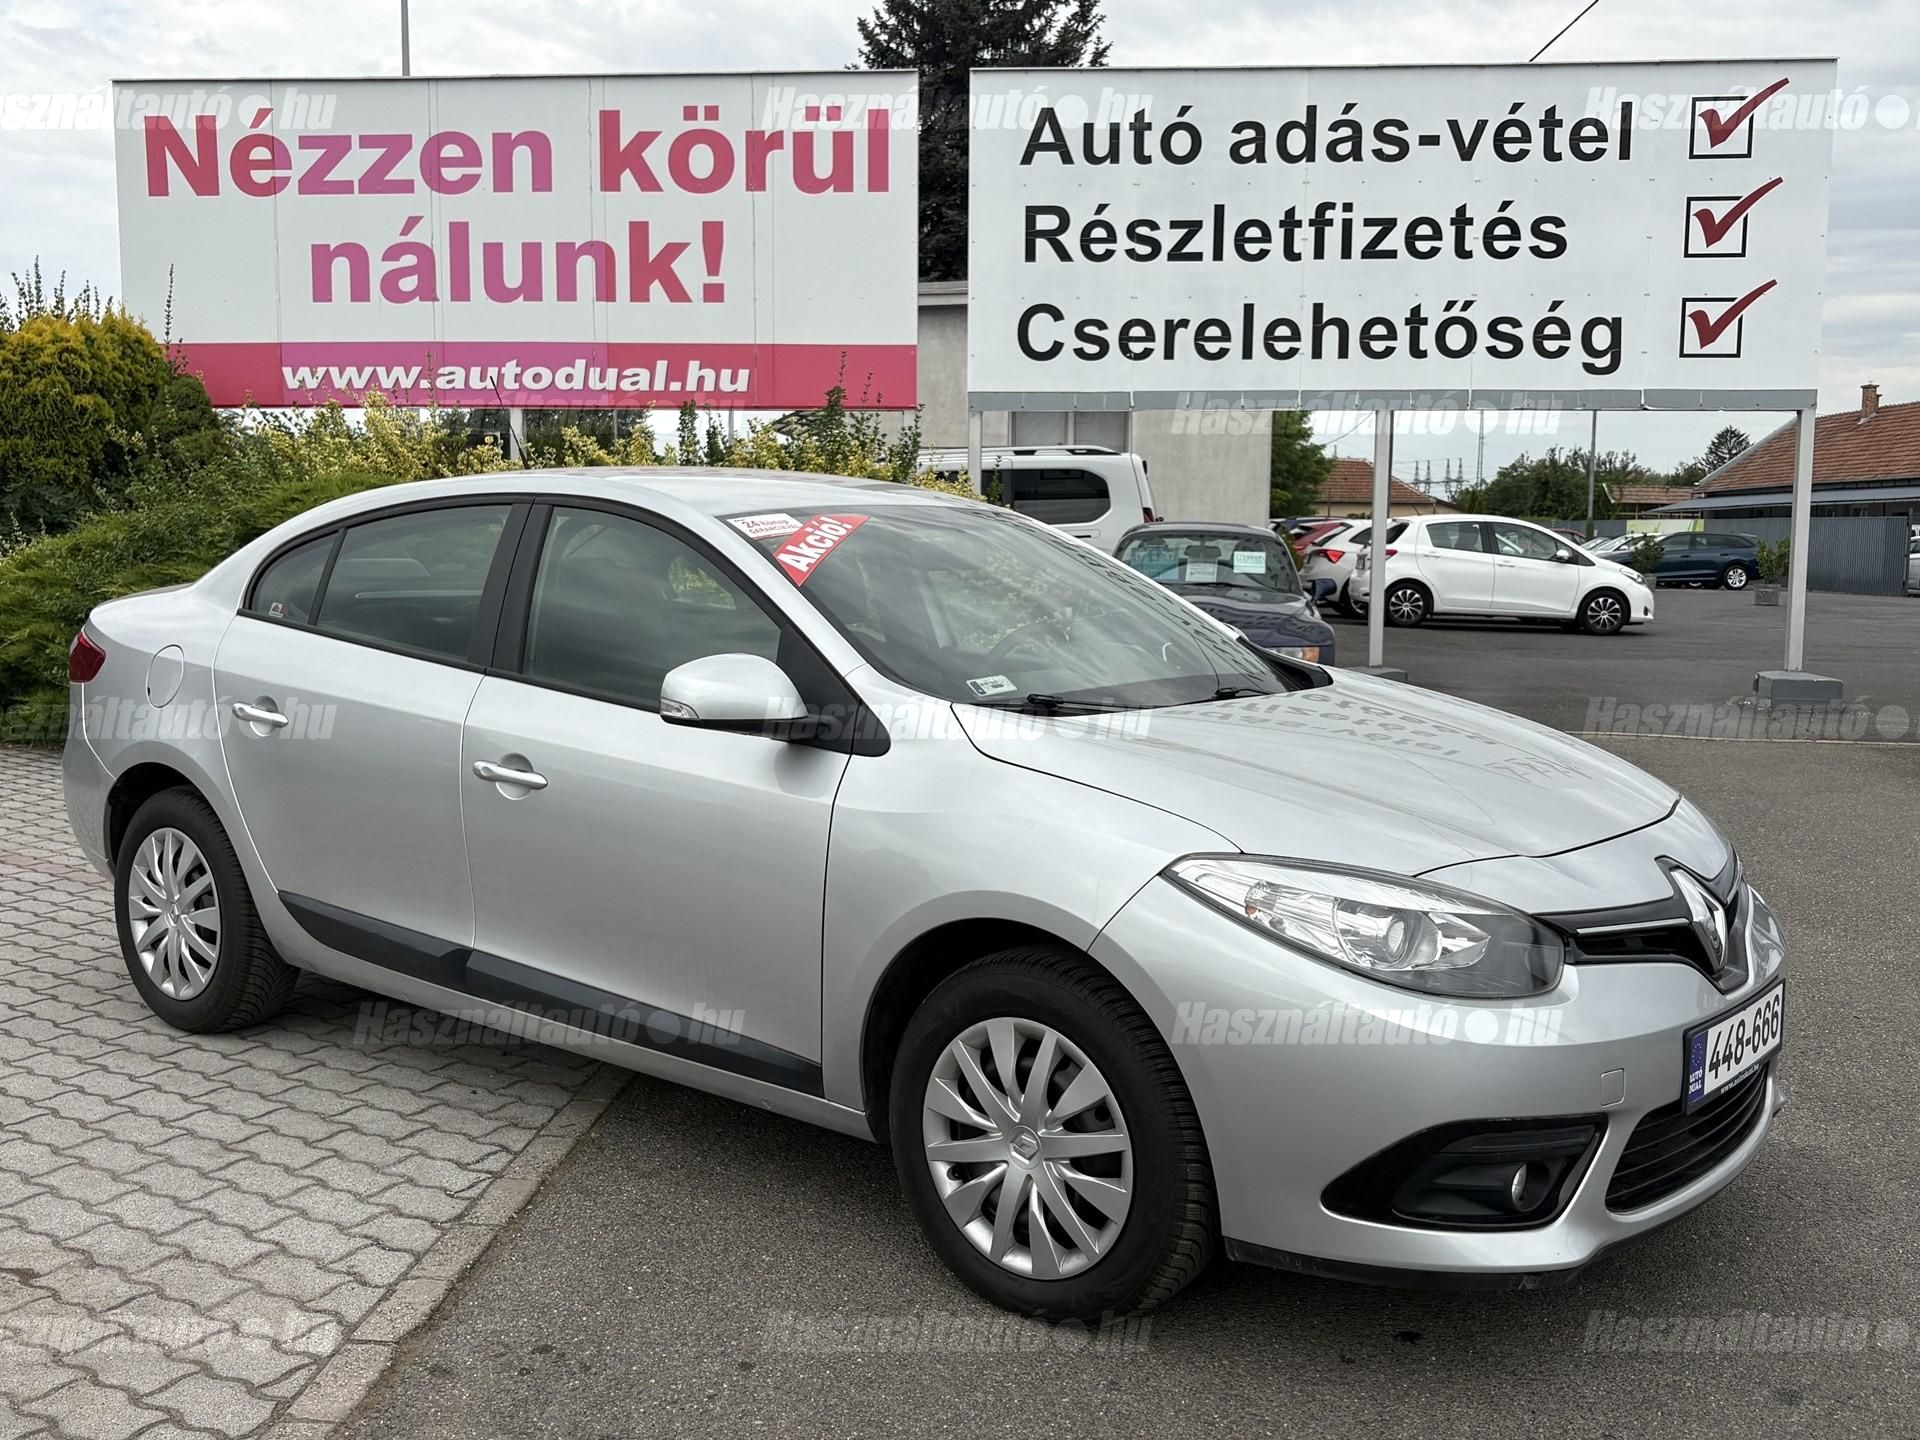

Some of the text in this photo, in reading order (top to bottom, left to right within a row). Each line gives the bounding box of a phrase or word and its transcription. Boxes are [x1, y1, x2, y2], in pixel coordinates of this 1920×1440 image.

[144, 105, 889, 197] Nézzen körül
[1019, 101, 1633, 166] Autó adás-vétel
[311, 216, 726, 304] nálunk!
[1024, 200, 1568, 263] Részletfizetés
[1016, 298, 1624, 375] Cserelehetőség
[281, 359, 750, 394] www.autodual.hu
[776, 516, 853, 572] Akció!
[1709, 994, 1780, 1079] 448-666
